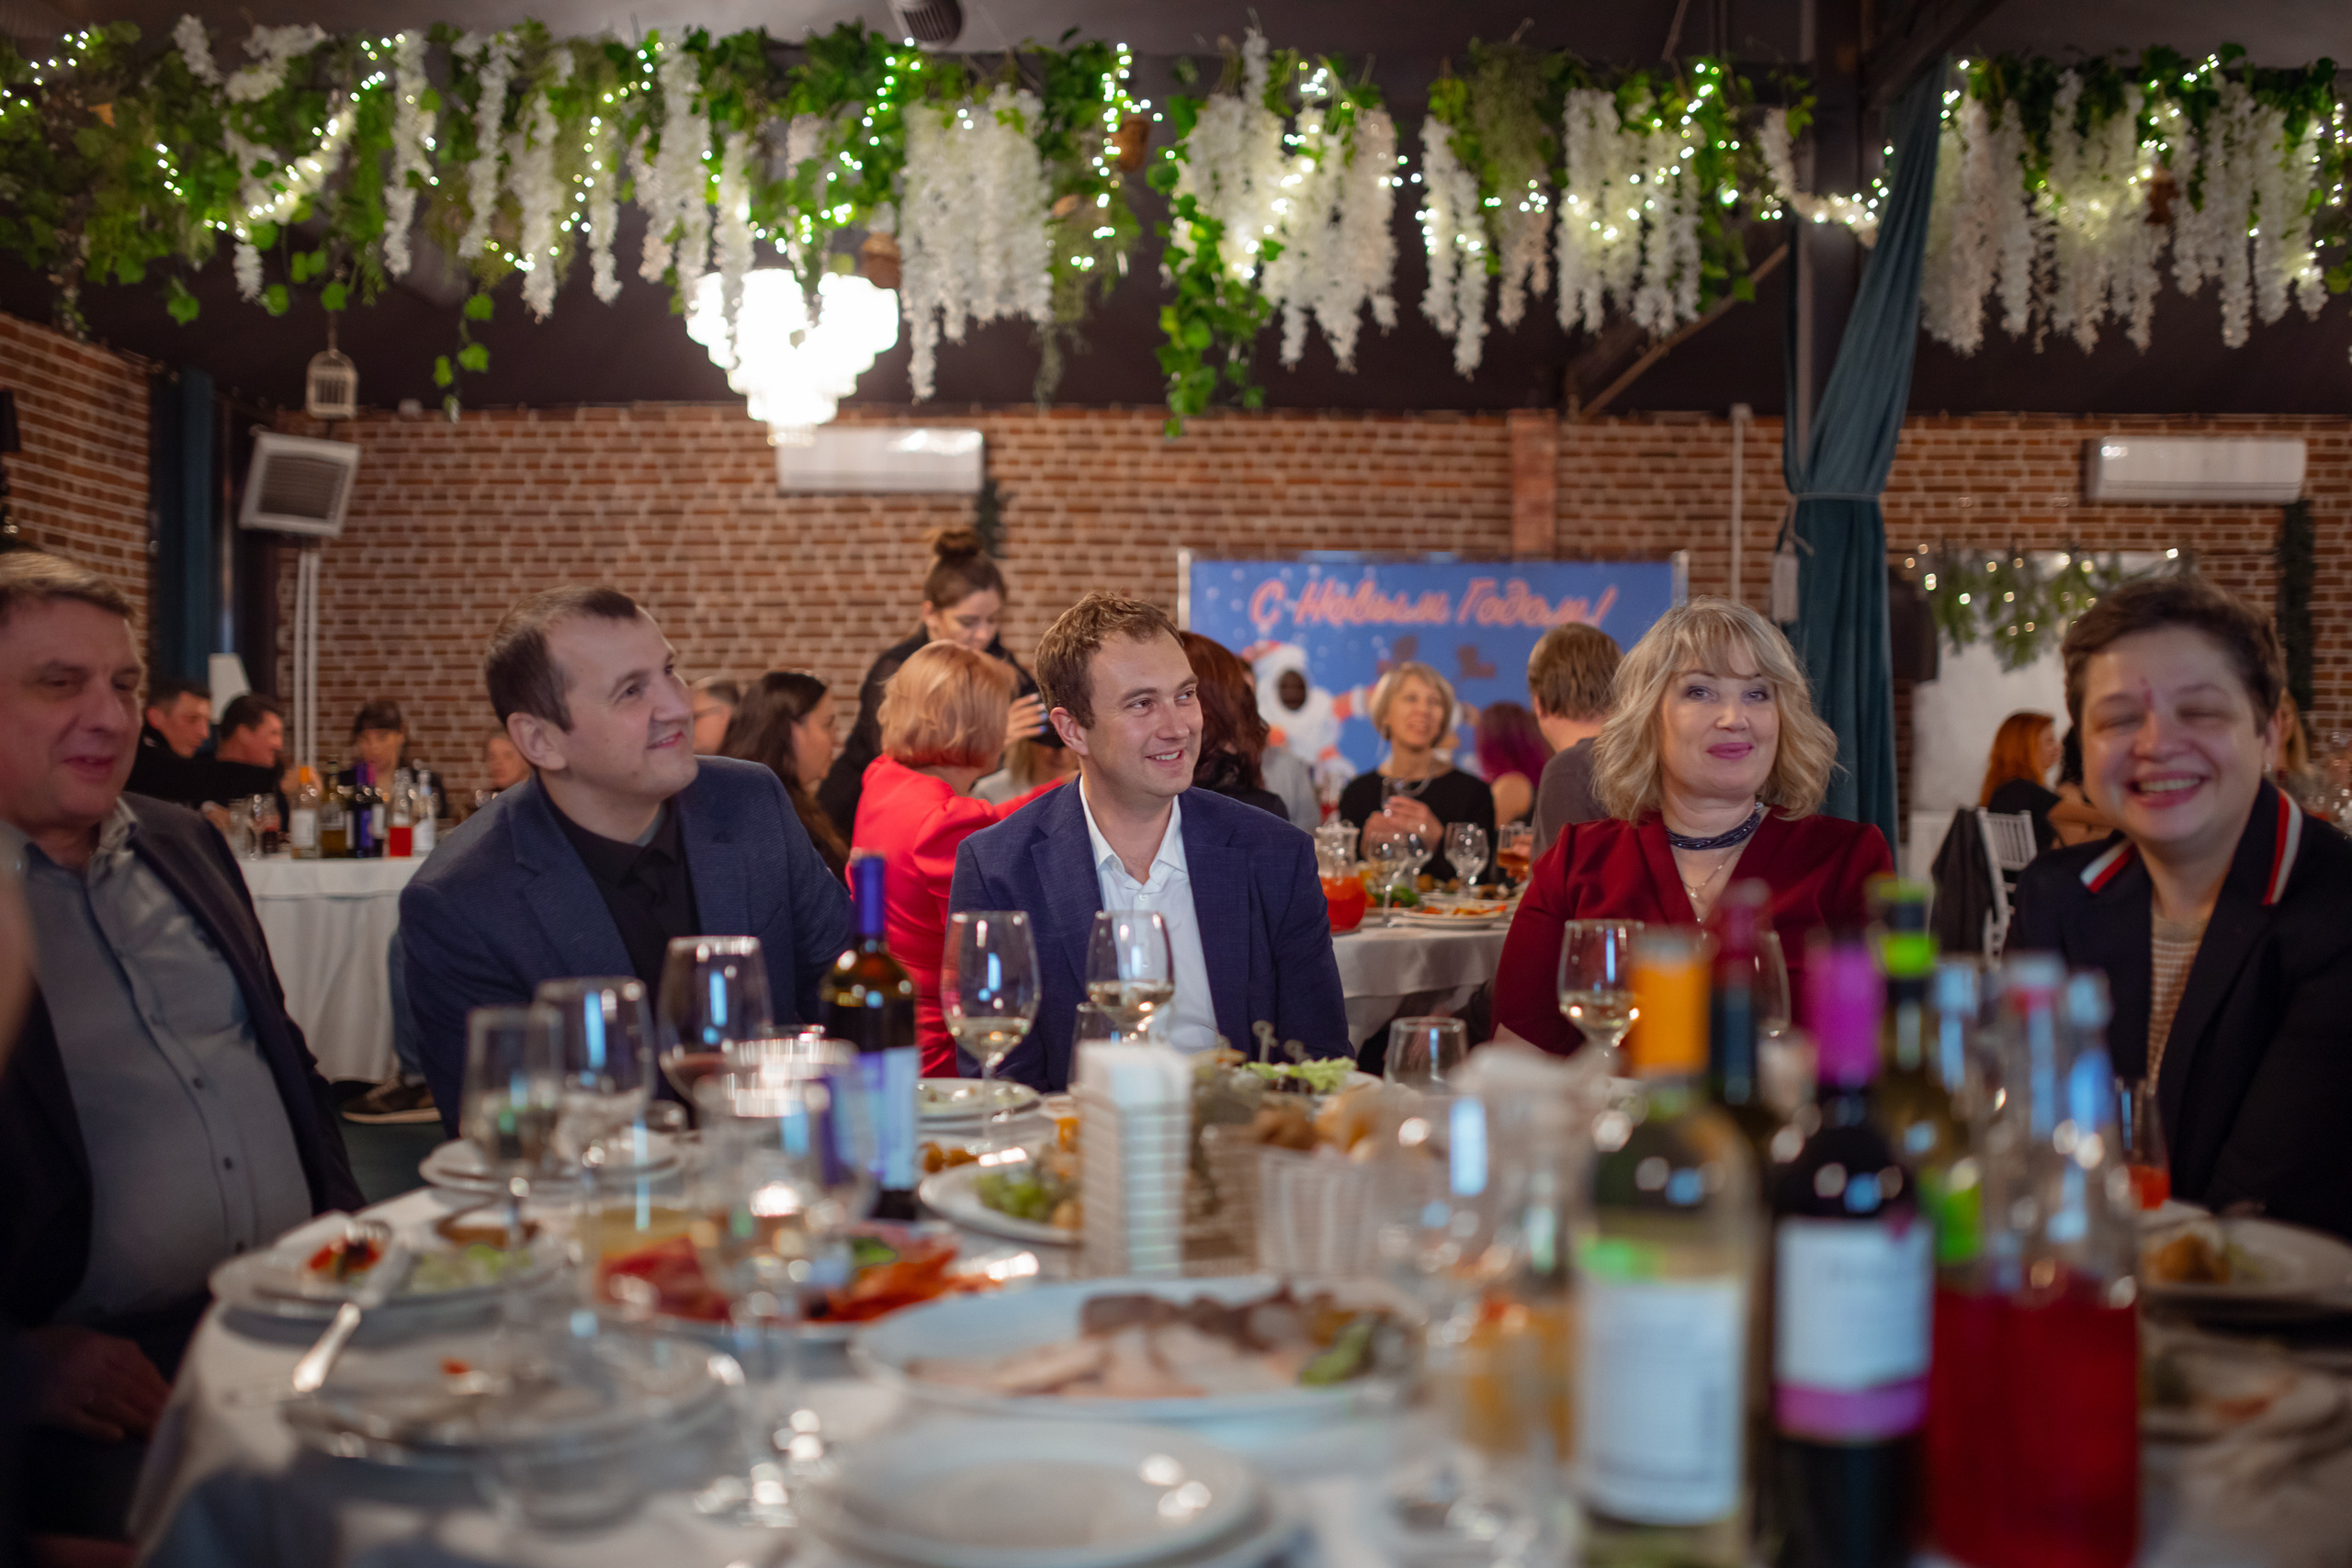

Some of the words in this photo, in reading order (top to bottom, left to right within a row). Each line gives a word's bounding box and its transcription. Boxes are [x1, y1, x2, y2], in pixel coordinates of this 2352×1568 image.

[1249, 578, 1285, 626] С
[1294, 578, 1450, 626] Новым
[1457, 577, 1619, 627] Годом!
